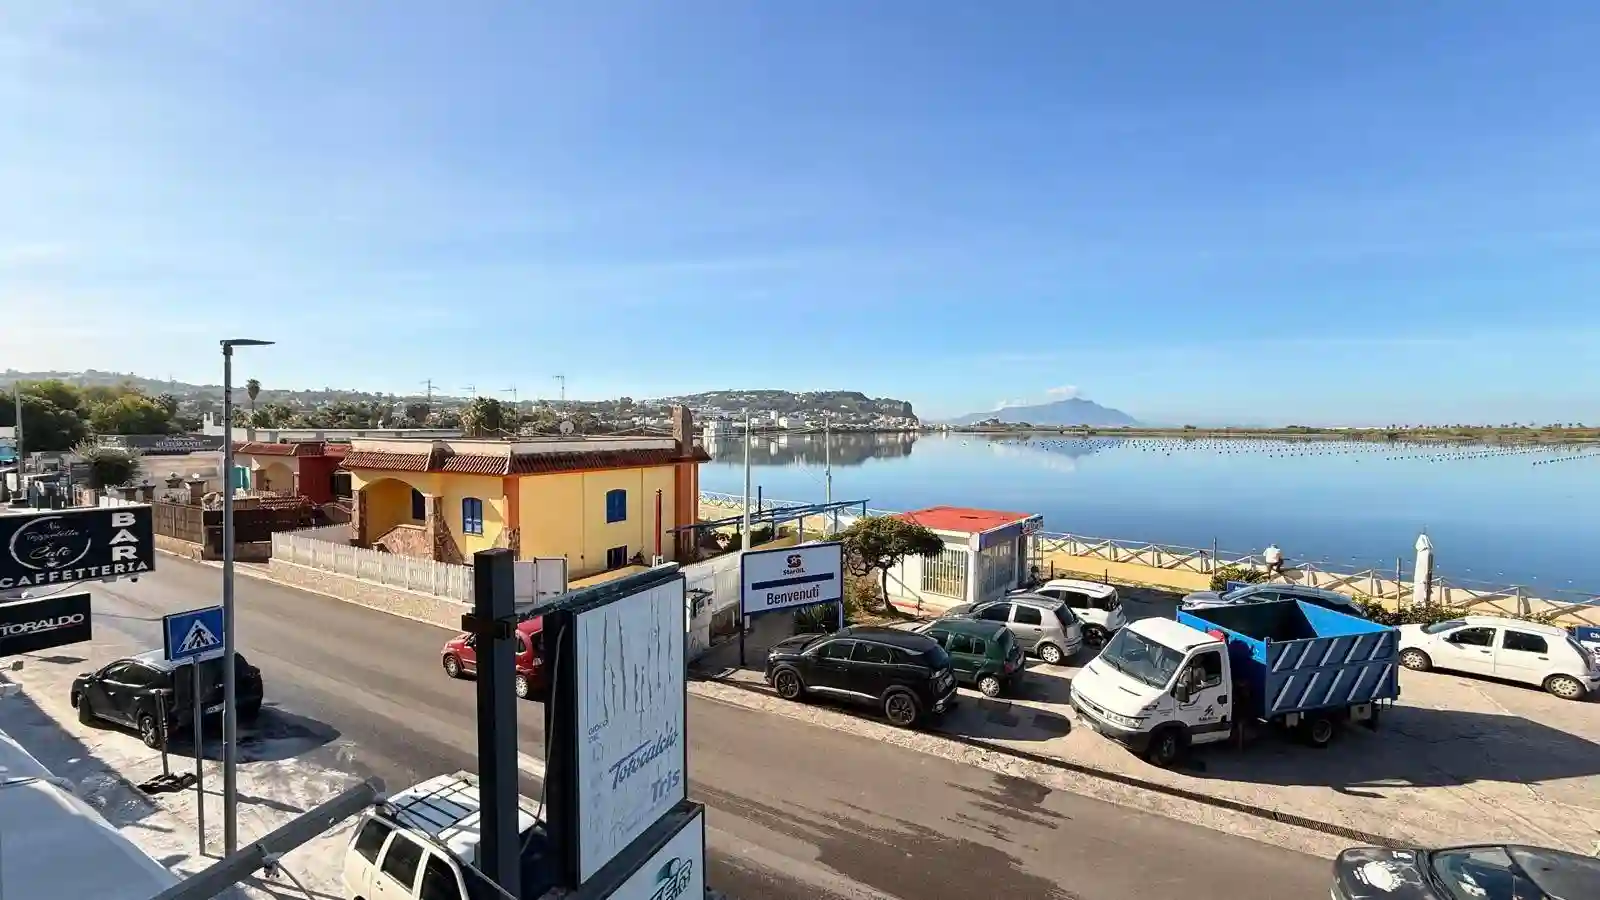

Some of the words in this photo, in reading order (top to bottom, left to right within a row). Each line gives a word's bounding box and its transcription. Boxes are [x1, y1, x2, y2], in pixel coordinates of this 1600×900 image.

[109, 512, 139, 562] BAR
[0, 561, 148, 588] CAFFETTERIA
[767, 585, 820, 605] Benvenuti
[0, 613, 84, 636] TORALDO
[651, 768, 680, 802] Tris
